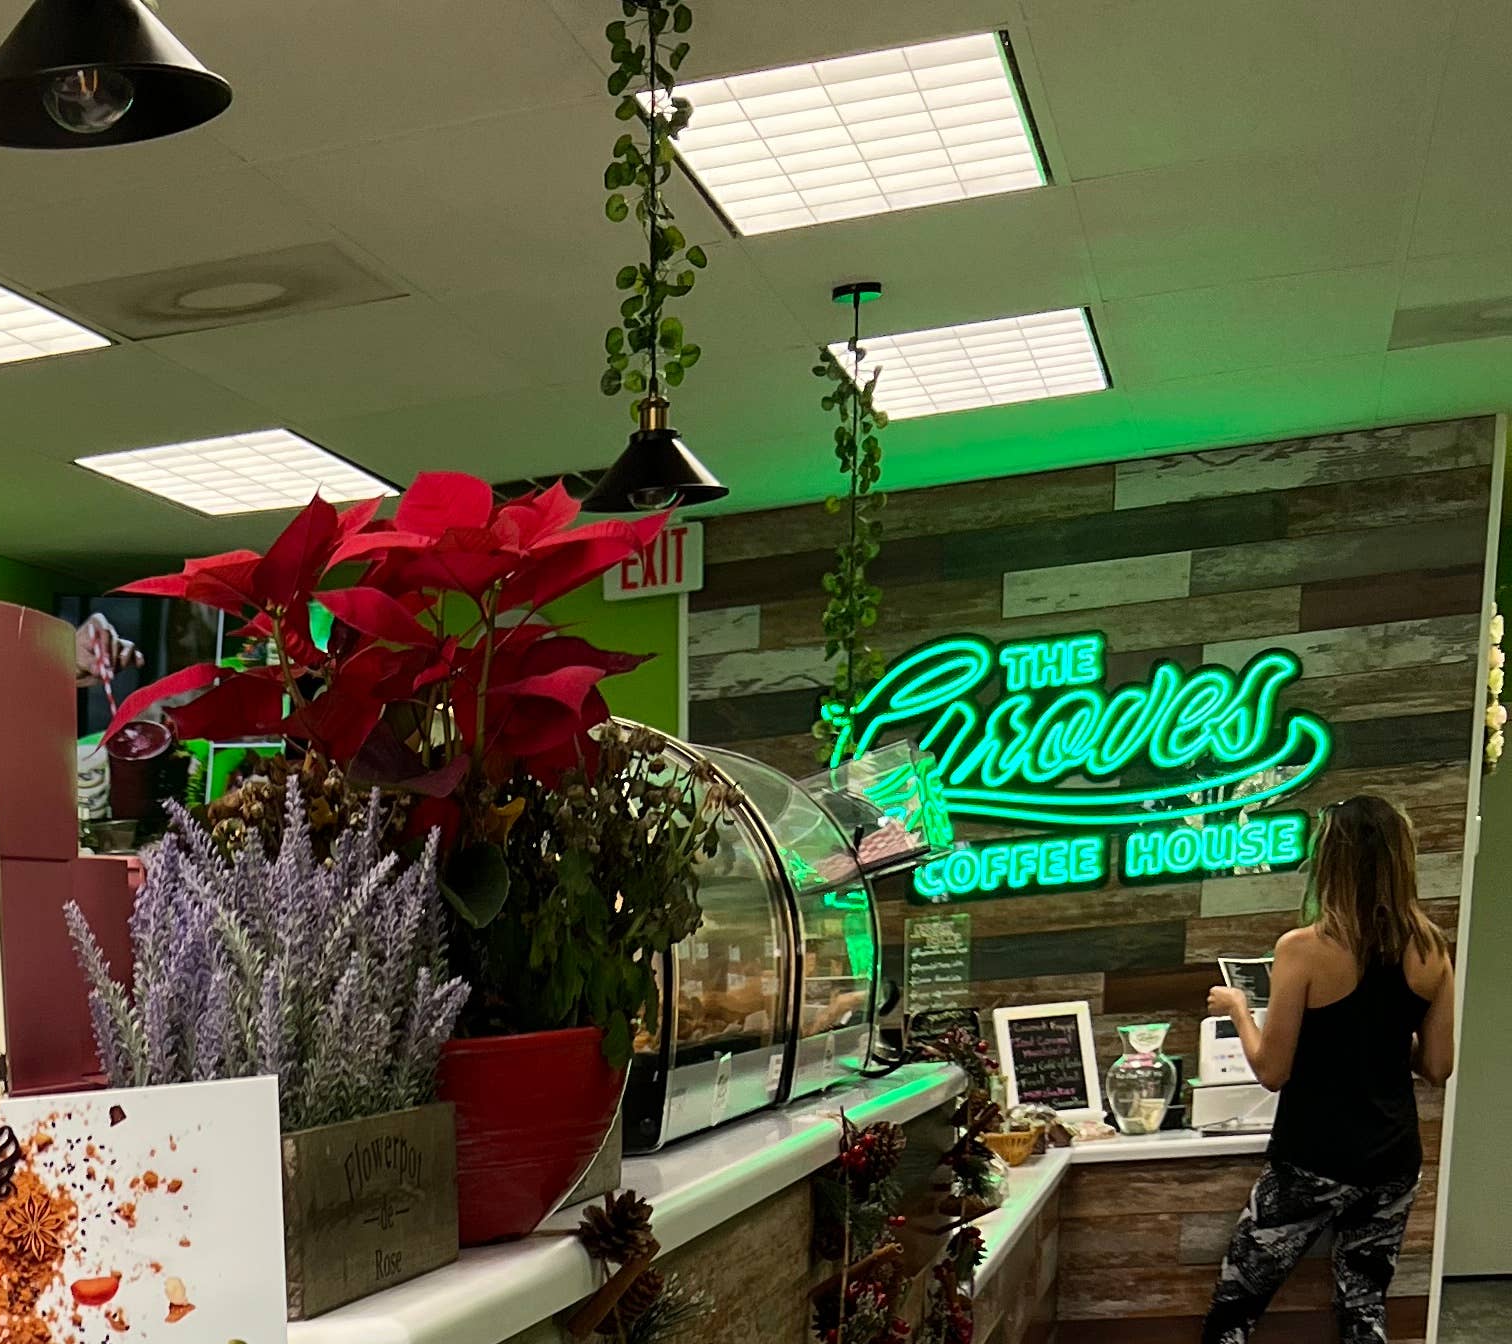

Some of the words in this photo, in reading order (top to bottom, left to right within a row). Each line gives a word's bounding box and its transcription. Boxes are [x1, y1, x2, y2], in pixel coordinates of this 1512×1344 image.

[621, 527, 688, 590] EXIT
[1000, 640, 1102, 691] THE
[914, 838, 1104, 897] COFFEE
[1125, 818, 1301, 878] HOUSE
[344, 1134, 423, 1201] Flowerpot
[375, 1249, 402, 1281] Rose
